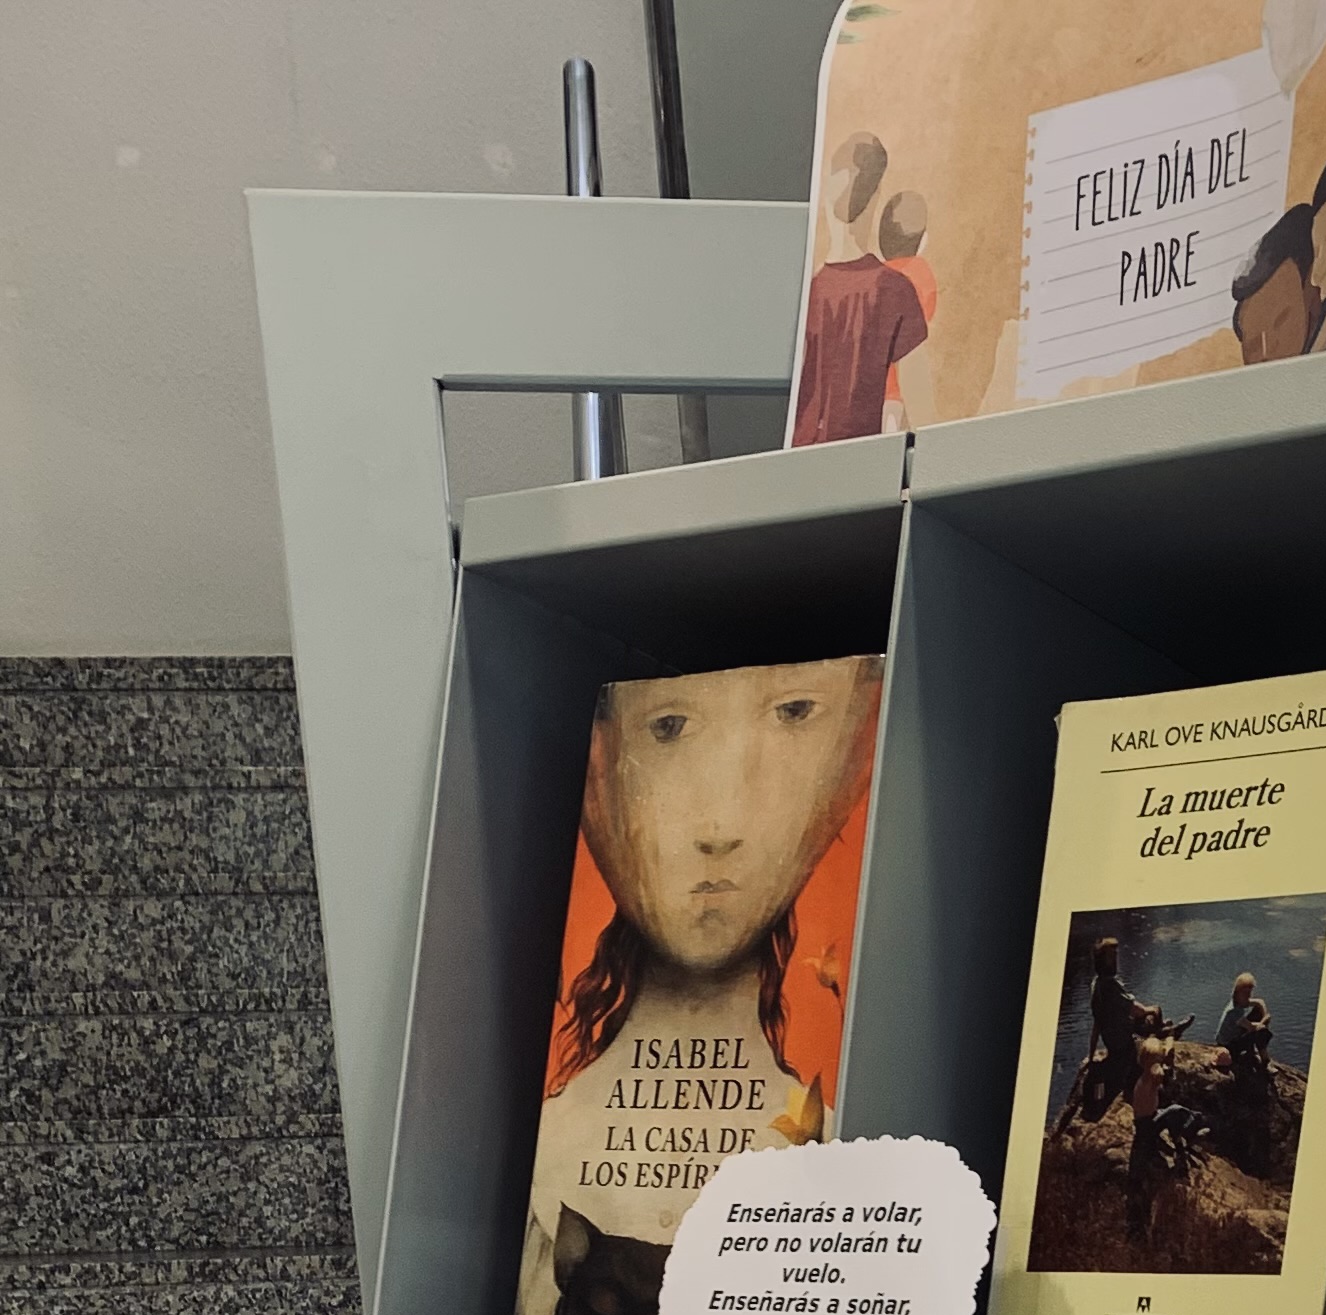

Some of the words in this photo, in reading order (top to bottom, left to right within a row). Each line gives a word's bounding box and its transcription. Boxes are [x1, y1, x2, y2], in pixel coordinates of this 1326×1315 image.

[1075, 160, 1145, 230] FELIZ
[1158, 141, 1195, 209] DÍA
[1208, 129, 1250, 195] DEL
[1120, 230, 1200, 305] PADRE
[1110, 729, 1158, 752] KARL
[1164, 724, 1203, 747] OVE
[1138, 787, 1172, 818] La
[1180, 779, 1285, 814] muerte
[1140, 826, 1183, 859] del
[1185, 821, 1271, 860] padre
[631, 1039, 750, 1069] ISABEL
[605, 1079, 766, 1111] ALLENDE
[605, 1126, 635, 1152] LA
[645, 1127, 708, 1153] CASA
[717, 1128, 755, 1154] DE
[579, 1161, 627, 1187] LOS
[635, 1159, 719, 1189] ESPÍR
[727, 1202, 835, 1224] Enseñarás
[842, 1206, 854, 1222] a
[862, 1202, 923, 1226] volar,
[718, 1234, 768, 1256] pero
[775, 1236, 801, 1253] no
[809, 1232, 888, 1253] volarán
[898, 1235, 922, 1254] tu
[783, 1263, 846, 1284] vuelo.
[709, 1289, 819, 1313] Enseñarás
[827, 1297, 838, 1313] a
